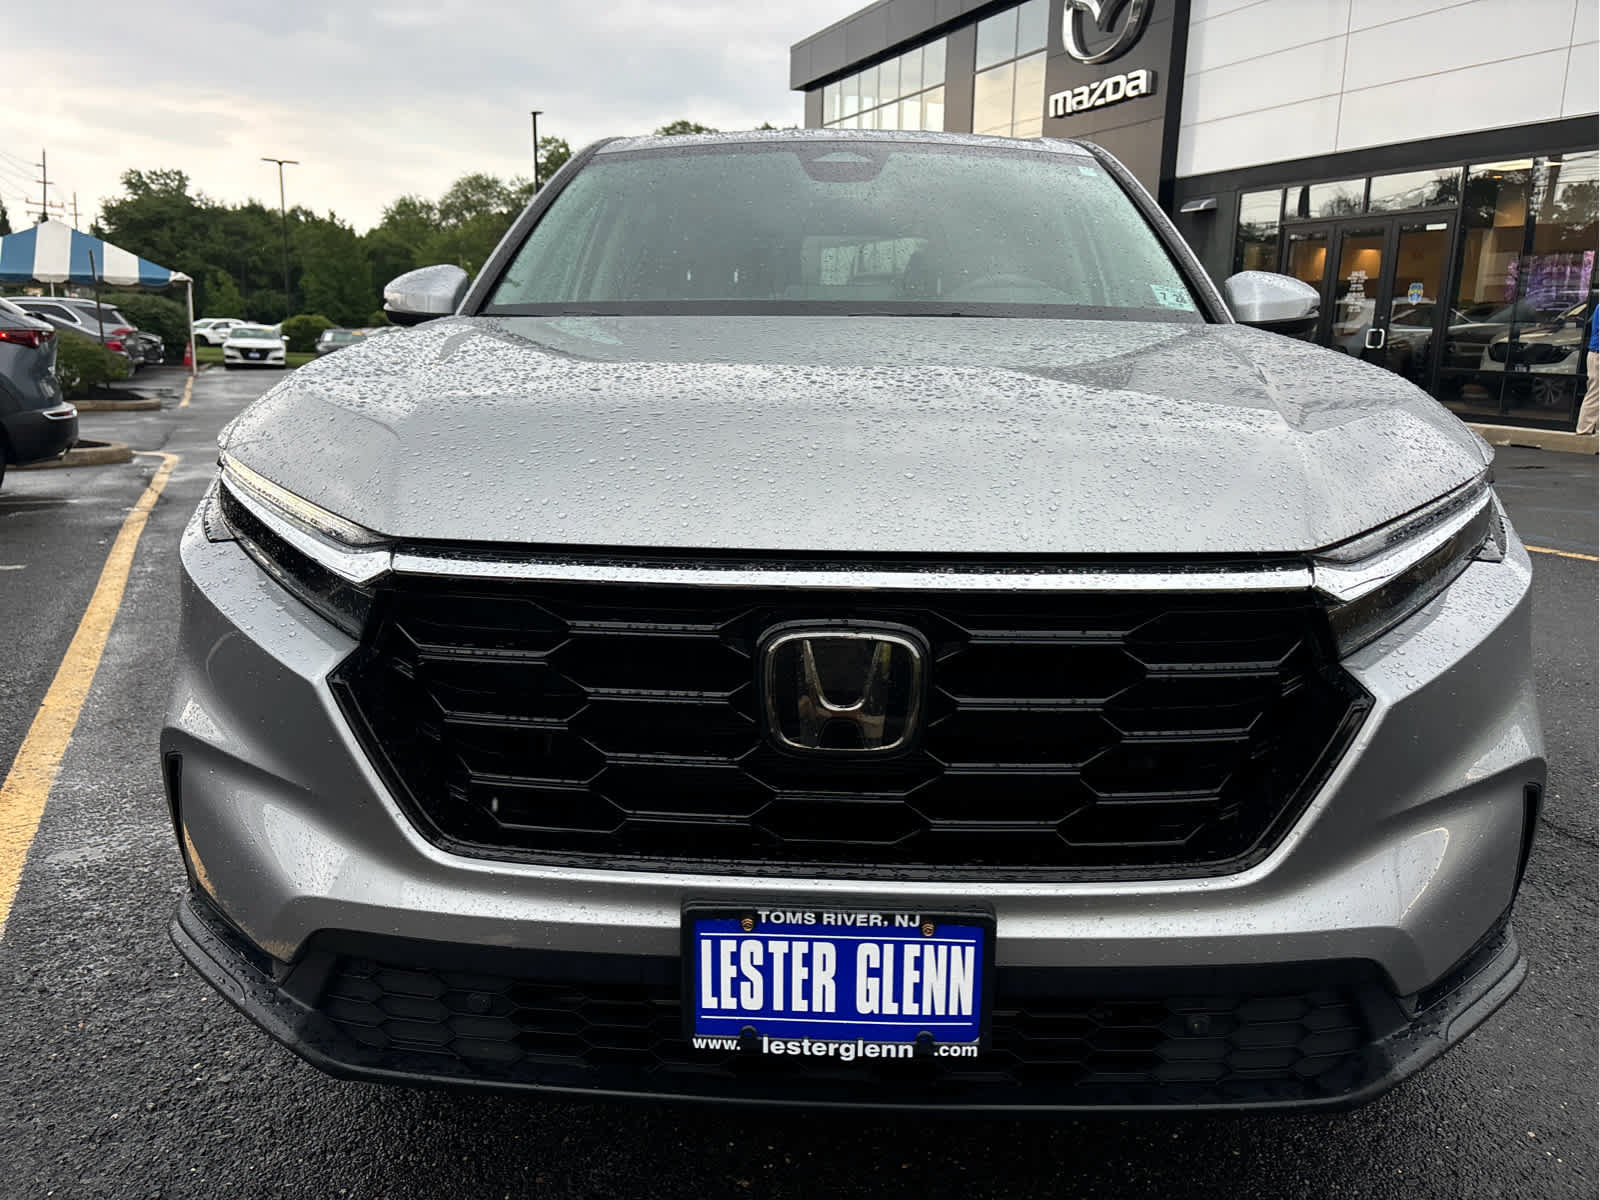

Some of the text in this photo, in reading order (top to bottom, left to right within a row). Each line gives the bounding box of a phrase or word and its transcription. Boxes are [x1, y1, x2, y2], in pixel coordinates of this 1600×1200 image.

[1049, 69, 1149, 118] mazda
[757, 911, 921, 927] TOMS RIVER, NJ
[701, 939, 976, 1016] LESTER GLENN
[693, 1036, 978, 1060] www. lesterglenn .com
